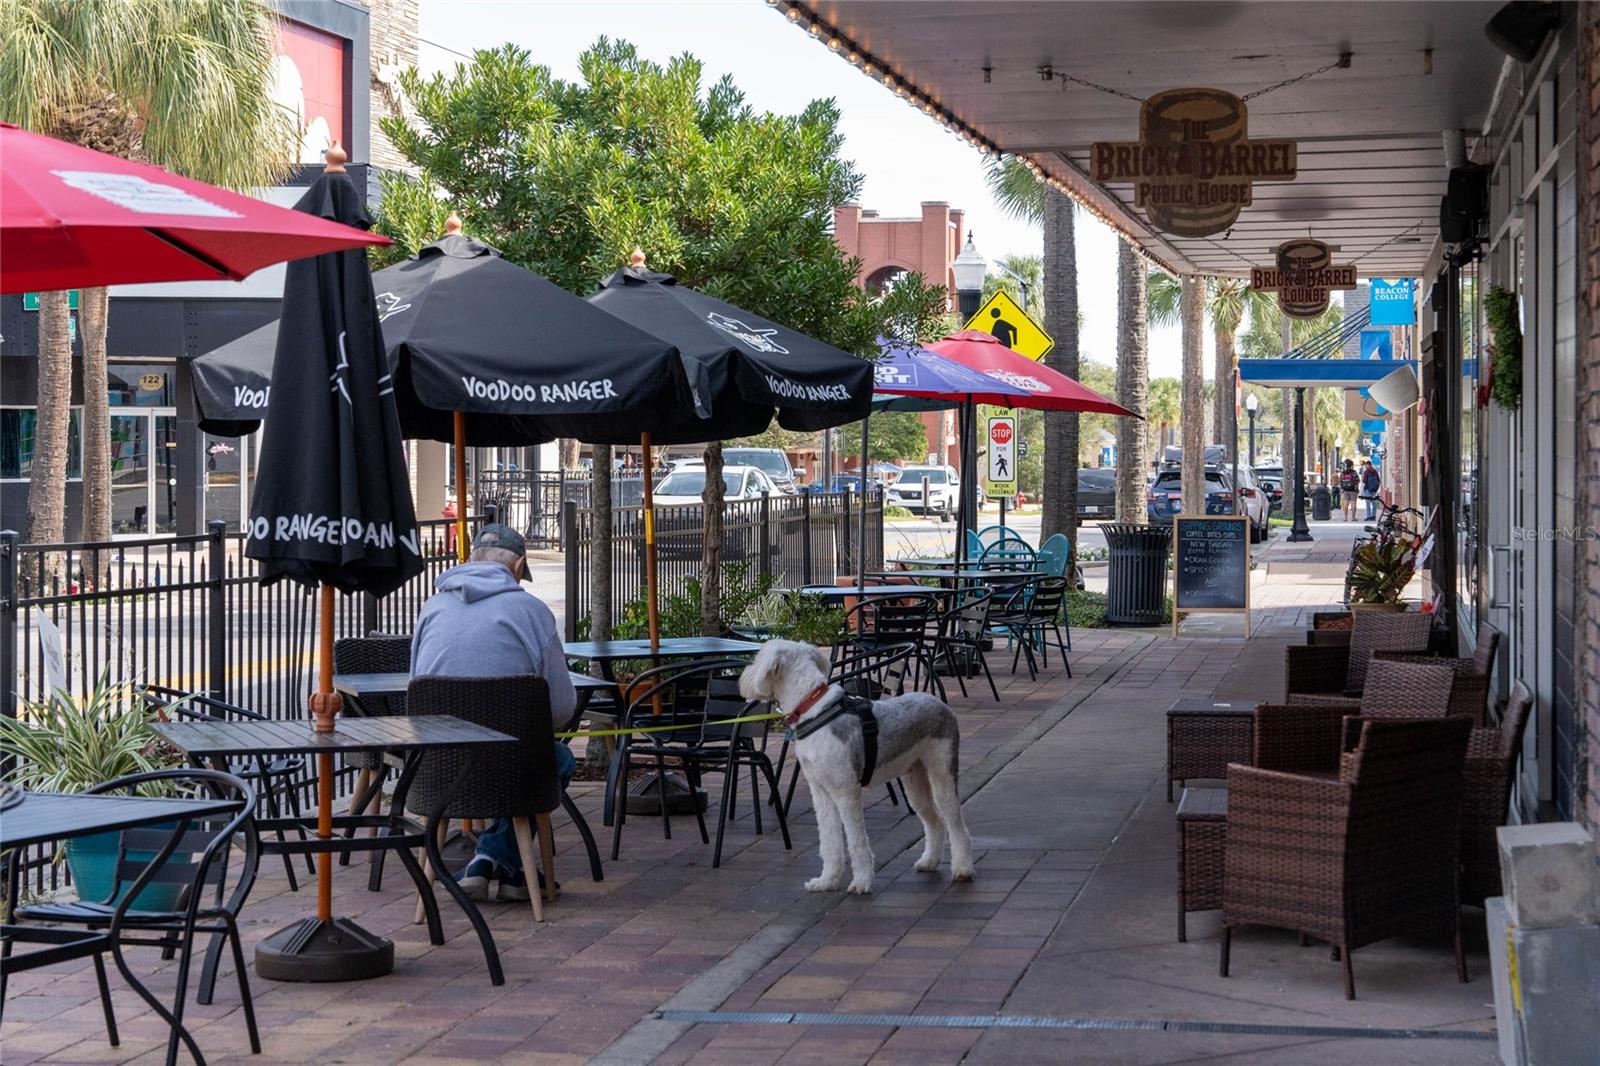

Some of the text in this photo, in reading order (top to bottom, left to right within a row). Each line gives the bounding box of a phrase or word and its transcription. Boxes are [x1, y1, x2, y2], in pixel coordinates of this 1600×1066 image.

[1180, 118, 1210, 142] THE
[1095, 141, 1296, 182] BRICK & BARREL
[1139, 181, 1250, 207] PUBLIC HOUSE
[1295, 256, 1313, 269] THE
[1253, 268, 1294, 289] BRICK
[1305, 268, 1357, 290] BARREL
[1375, 286, 1410, 295] BEACON
[1375, 293, 1409, 301] COLLEGE
[143, 375, 160, 384] 122
[461, 376, 619, 403] VOODOO RANGER
[765, 375, 853, 401] VOODOO RANGER
[994, 408, 1010, 417] LAW
[992, 427, 1012, 439] STOP
[988, 488, 1015, 496] CROSSWALK
